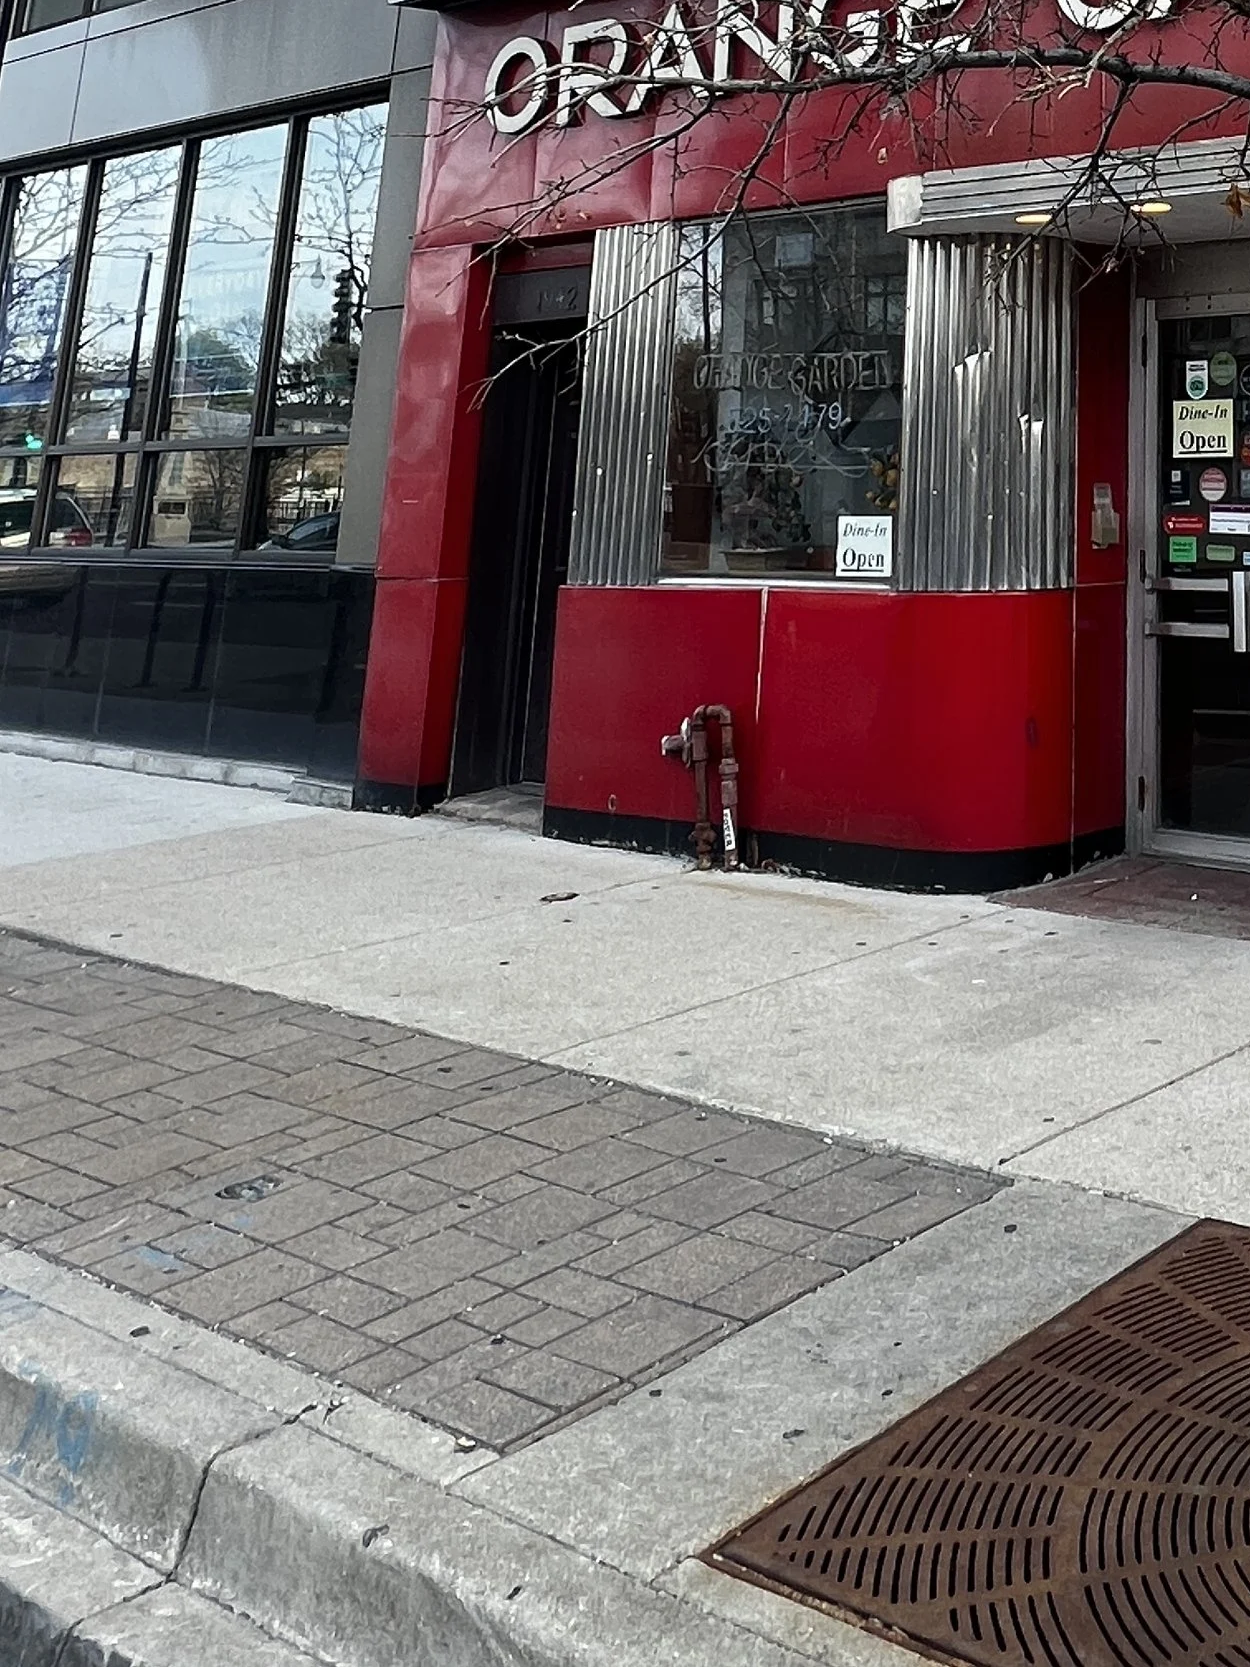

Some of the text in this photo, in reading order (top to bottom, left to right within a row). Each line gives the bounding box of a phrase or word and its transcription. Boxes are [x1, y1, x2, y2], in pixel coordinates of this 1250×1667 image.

[788, 350, 893, 394] GARDEN
[1178, 404, 1228, 421] Dine-In
[1179, 430, 1227, 452] Open
[843, 521, 887, 538] Dine-In
[842, 547, 885, 569] Open
